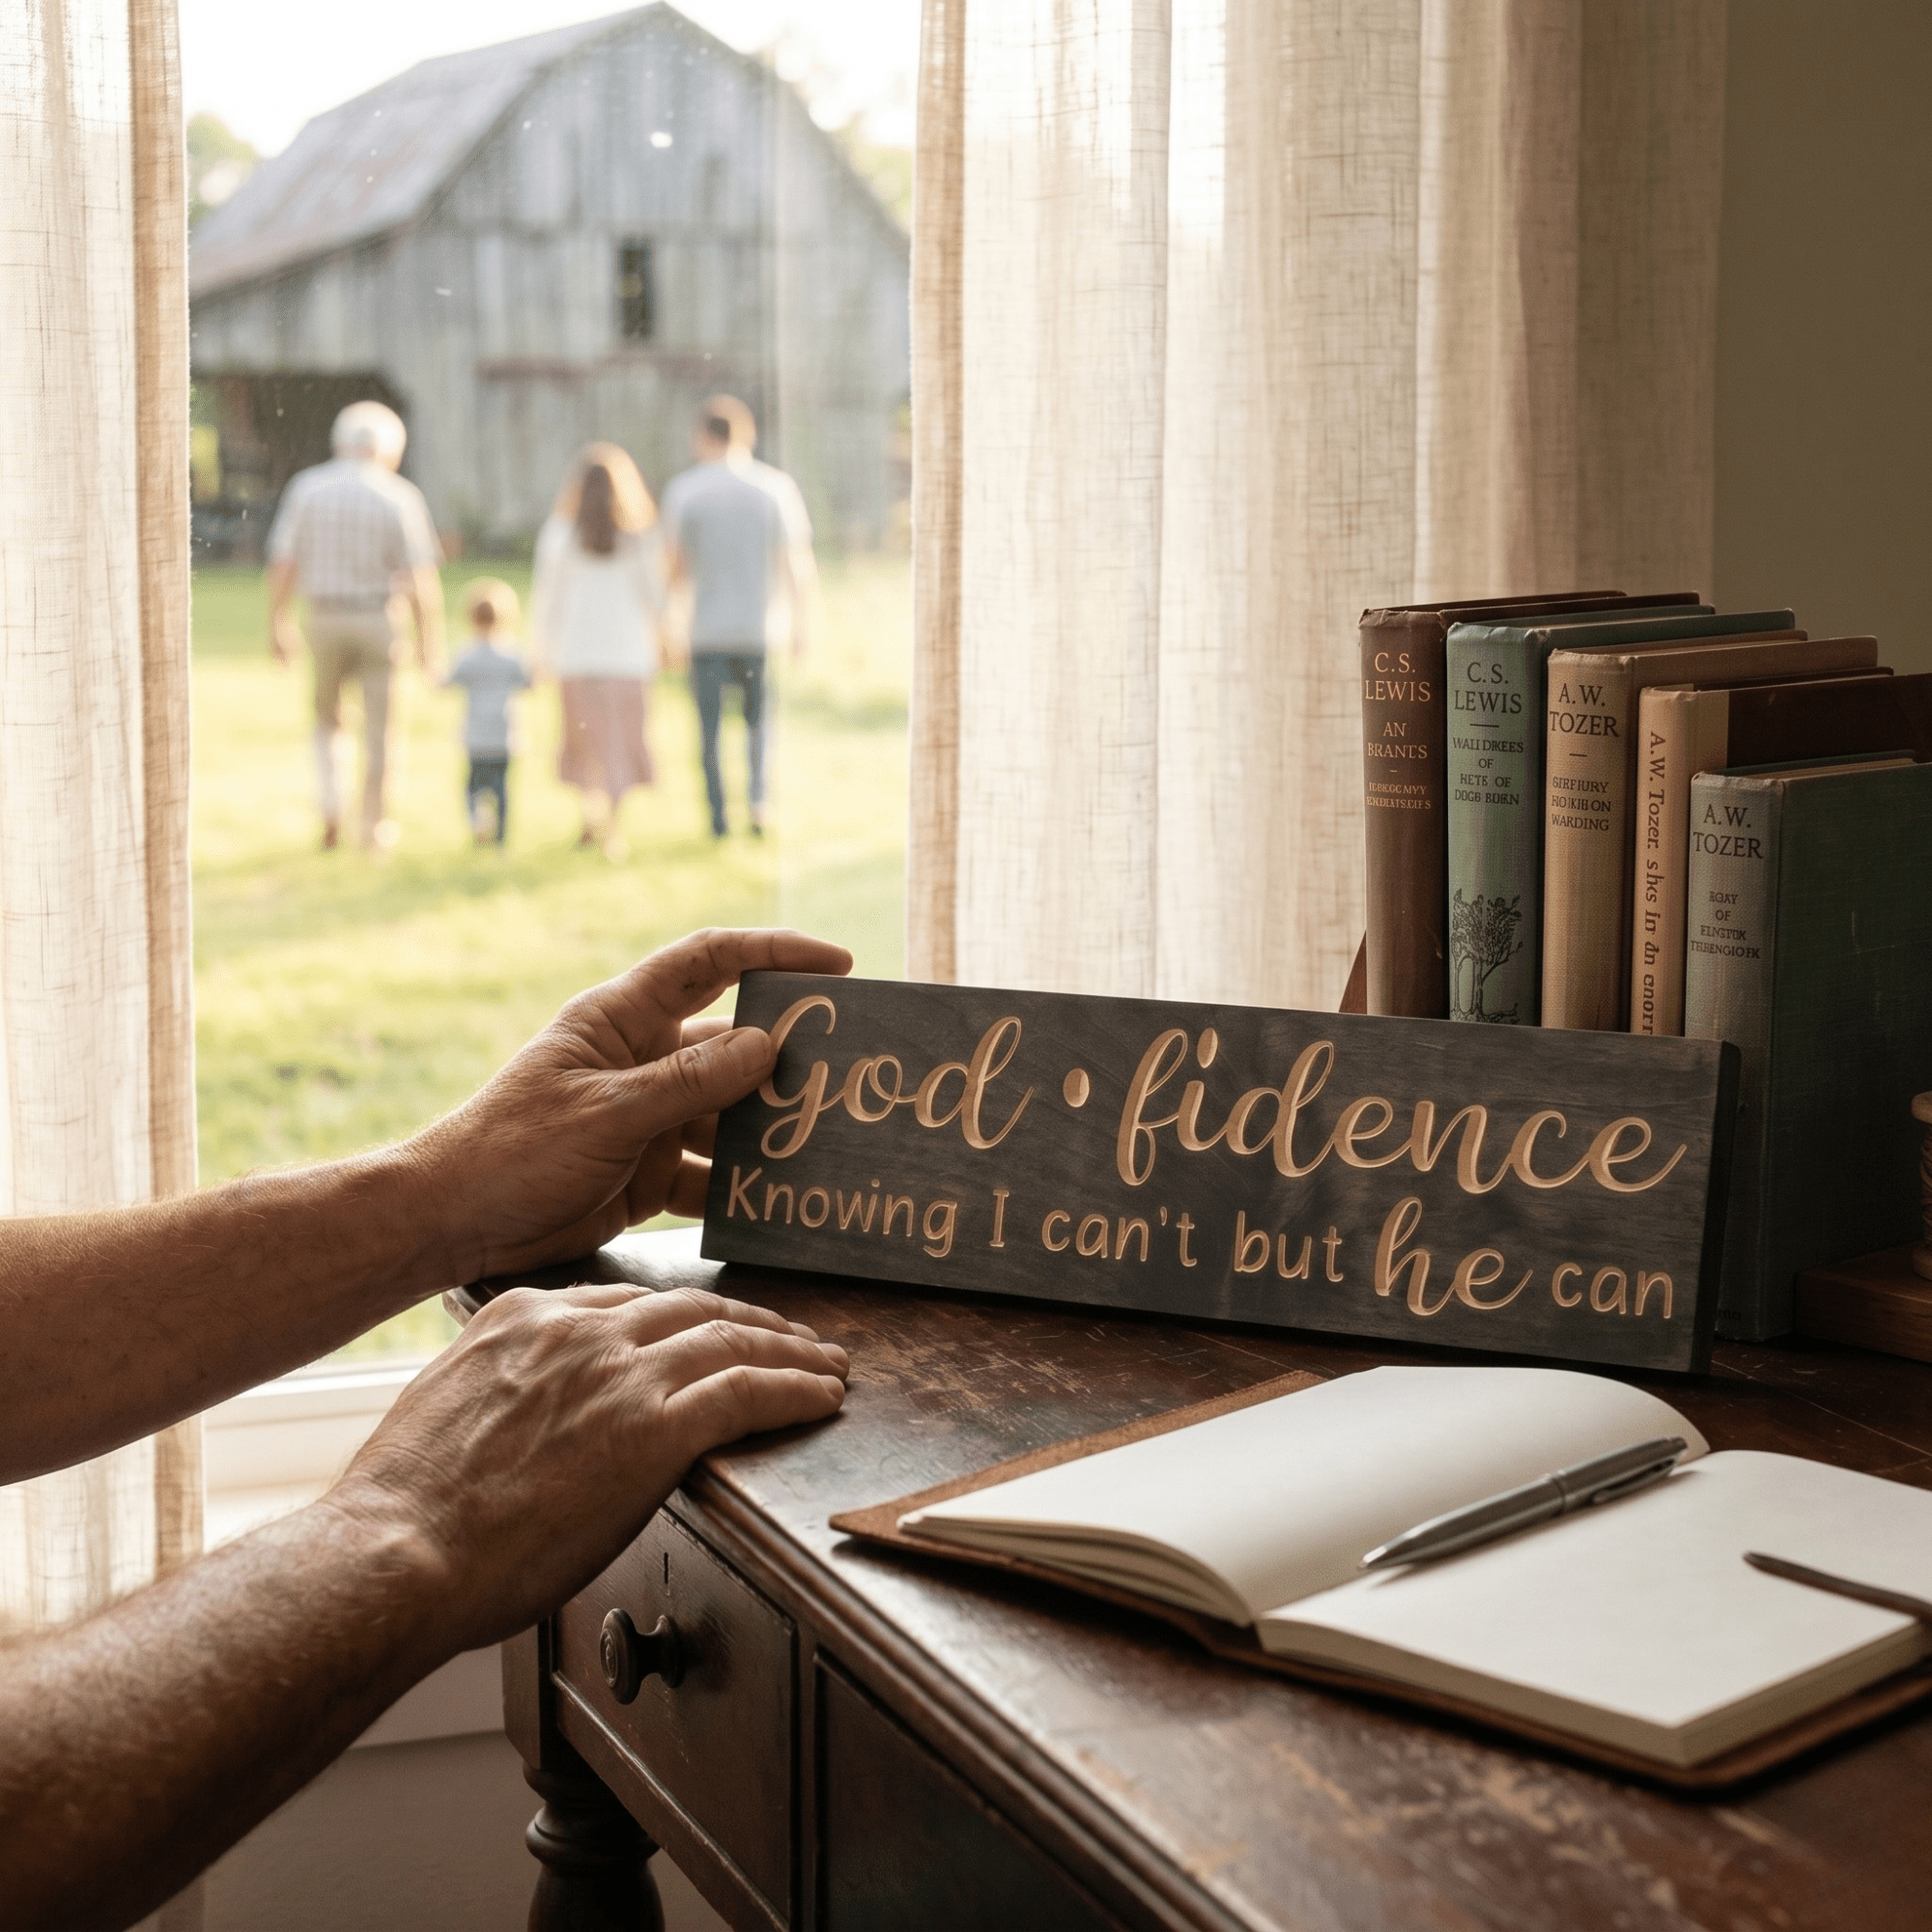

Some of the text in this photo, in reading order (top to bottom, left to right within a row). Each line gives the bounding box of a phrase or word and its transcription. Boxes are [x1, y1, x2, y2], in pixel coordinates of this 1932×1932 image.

[1365, 680, 1432, 702] LEWIS
[1454, 690, 1522, 714] LEWIS
[1383, 723, 1406, 737] AN
[1549, 711, 1620, 737] TOZER
[1478, 758, 1493, 769] OF
[1494, 776, 1512, 788] OF
[1551, 813, 1609, 831] WARDING
[1693, 832, 1764, 859] TOZER
[1716, 910, 1731, 922] OF
[757, 995, 1035, 1159] God
[1117, 1028, 1688, 1194] fidence
[727, 1166, 1673, 1319] Knowing I can't but he can
